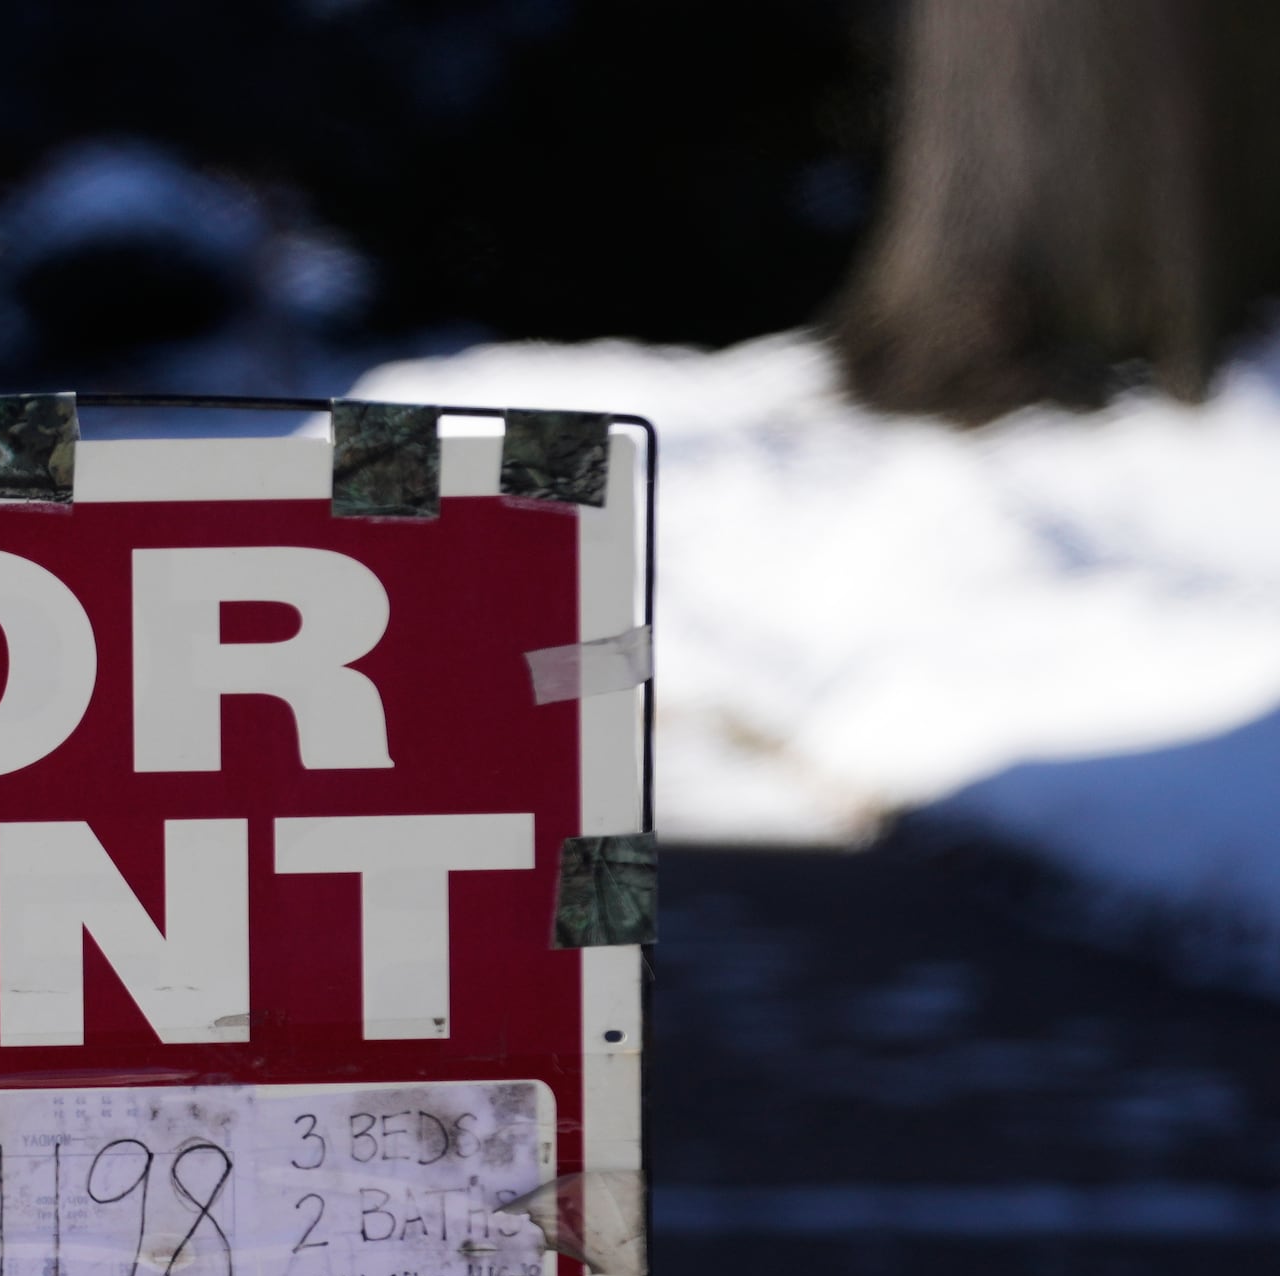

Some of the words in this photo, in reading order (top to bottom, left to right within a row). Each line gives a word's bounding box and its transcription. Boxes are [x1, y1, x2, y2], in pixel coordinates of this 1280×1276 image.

[291, 1113, 326, 1170] 3
[349, 1109, 481, 1166] BEDS
[292, 1193, 329, 1255] 2
